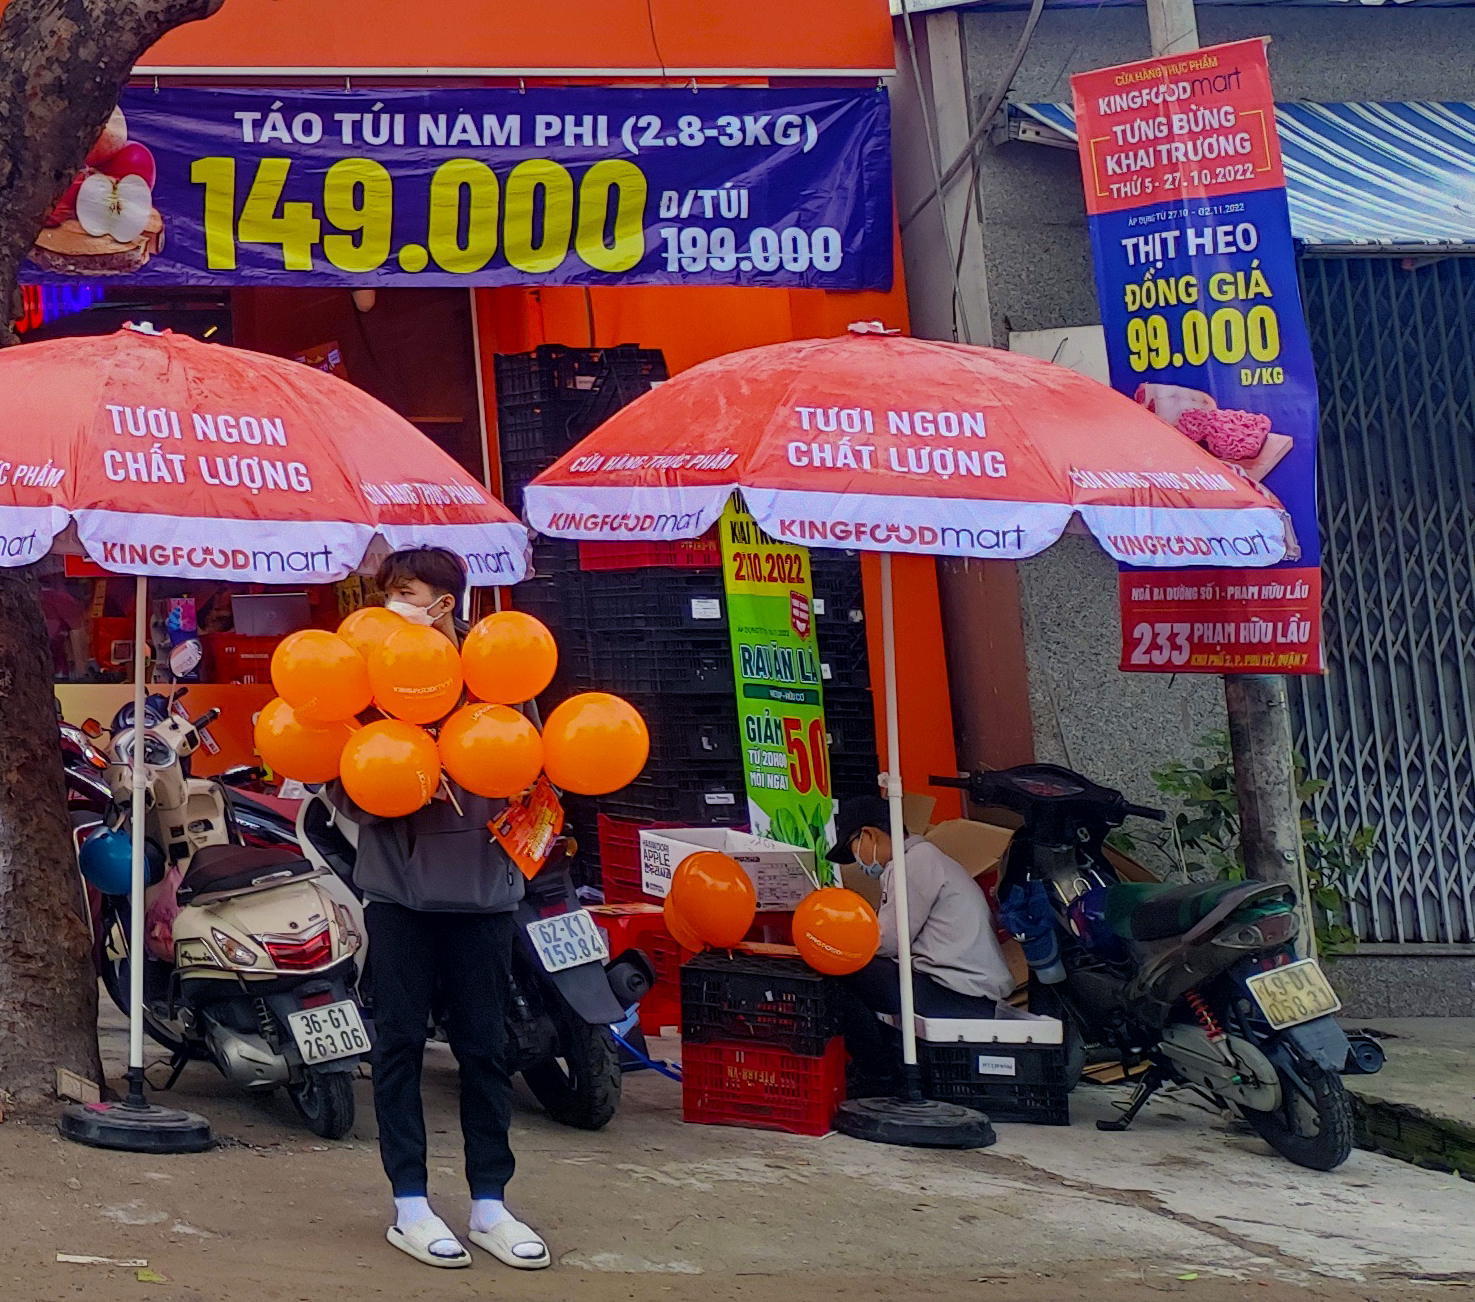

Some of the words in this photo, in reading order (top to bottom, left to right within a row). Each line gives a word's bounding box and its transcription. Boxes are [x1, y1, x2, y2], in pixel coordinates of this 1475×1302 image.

[234, 100, 324, 147] TÁO
[334, 100, 419, 147] TÚI
[427, 113, 524, 148] NAM
[535, 113, 612, 148] PHI
[621, 113, 821, 156] (2.8-3KG)
[1113, 116, 1168, 145] TƯNG
[1172, 104, 1236, 135] BỪNG
[1106, 148, 1155, 175] KHAI
[1157, 132, 1252, 165] TRƯƠNG
[659, 186, 749, 221] Đ/TÚI
[1110, 175, 1142, 199] THỨ
[191, 155, 648, 275] 149.000
[660, 225, 844, 275] 199.000
[1122, 230, 1180, 269] THỊT
[1187, 223, 1258, 256] HEO
[1125, 266, 1198, 312] ĐỒNG
[1209, 259, 1273, 302] GIÁ
[1127, 305, 1280, 372] 99.000
[1240, 367, 1284, 386] Đ/KG
[105, 404, 183, 439] TƯƠI
[192, 413, 288, 446] NGON
[795, 406, 875, 434] TƯƠI
[887, 410, 987, 438] NGON
[11, 458, 66, 488] PHẨM
[104, 443, 186, 483] CHẤT
[198, 454, 312, 494] LƯỢNG
[569, 453, 602, 473] CỬA
[787, 436, 875, 470] CHẤT
[889, 446, 1007, 479] LƯỢNG
[1227, 585, 1259, 604] PHẠM
[1261, 582, 1284, 601] HỮU
[1130, 622, 1191, 666] 233
[1193, 621, 1235, 651] PHẠM
[1239, 616, 1273, 644] HỮU
[643, 849, 671, 867] APPLE
[539, 915, 585, 944] 62-K1
[543, 934, 602, 967] 159.84
[300, 1007, 350, 1036] 36-G1
[304, 1027, 364, 1059] 263.06
